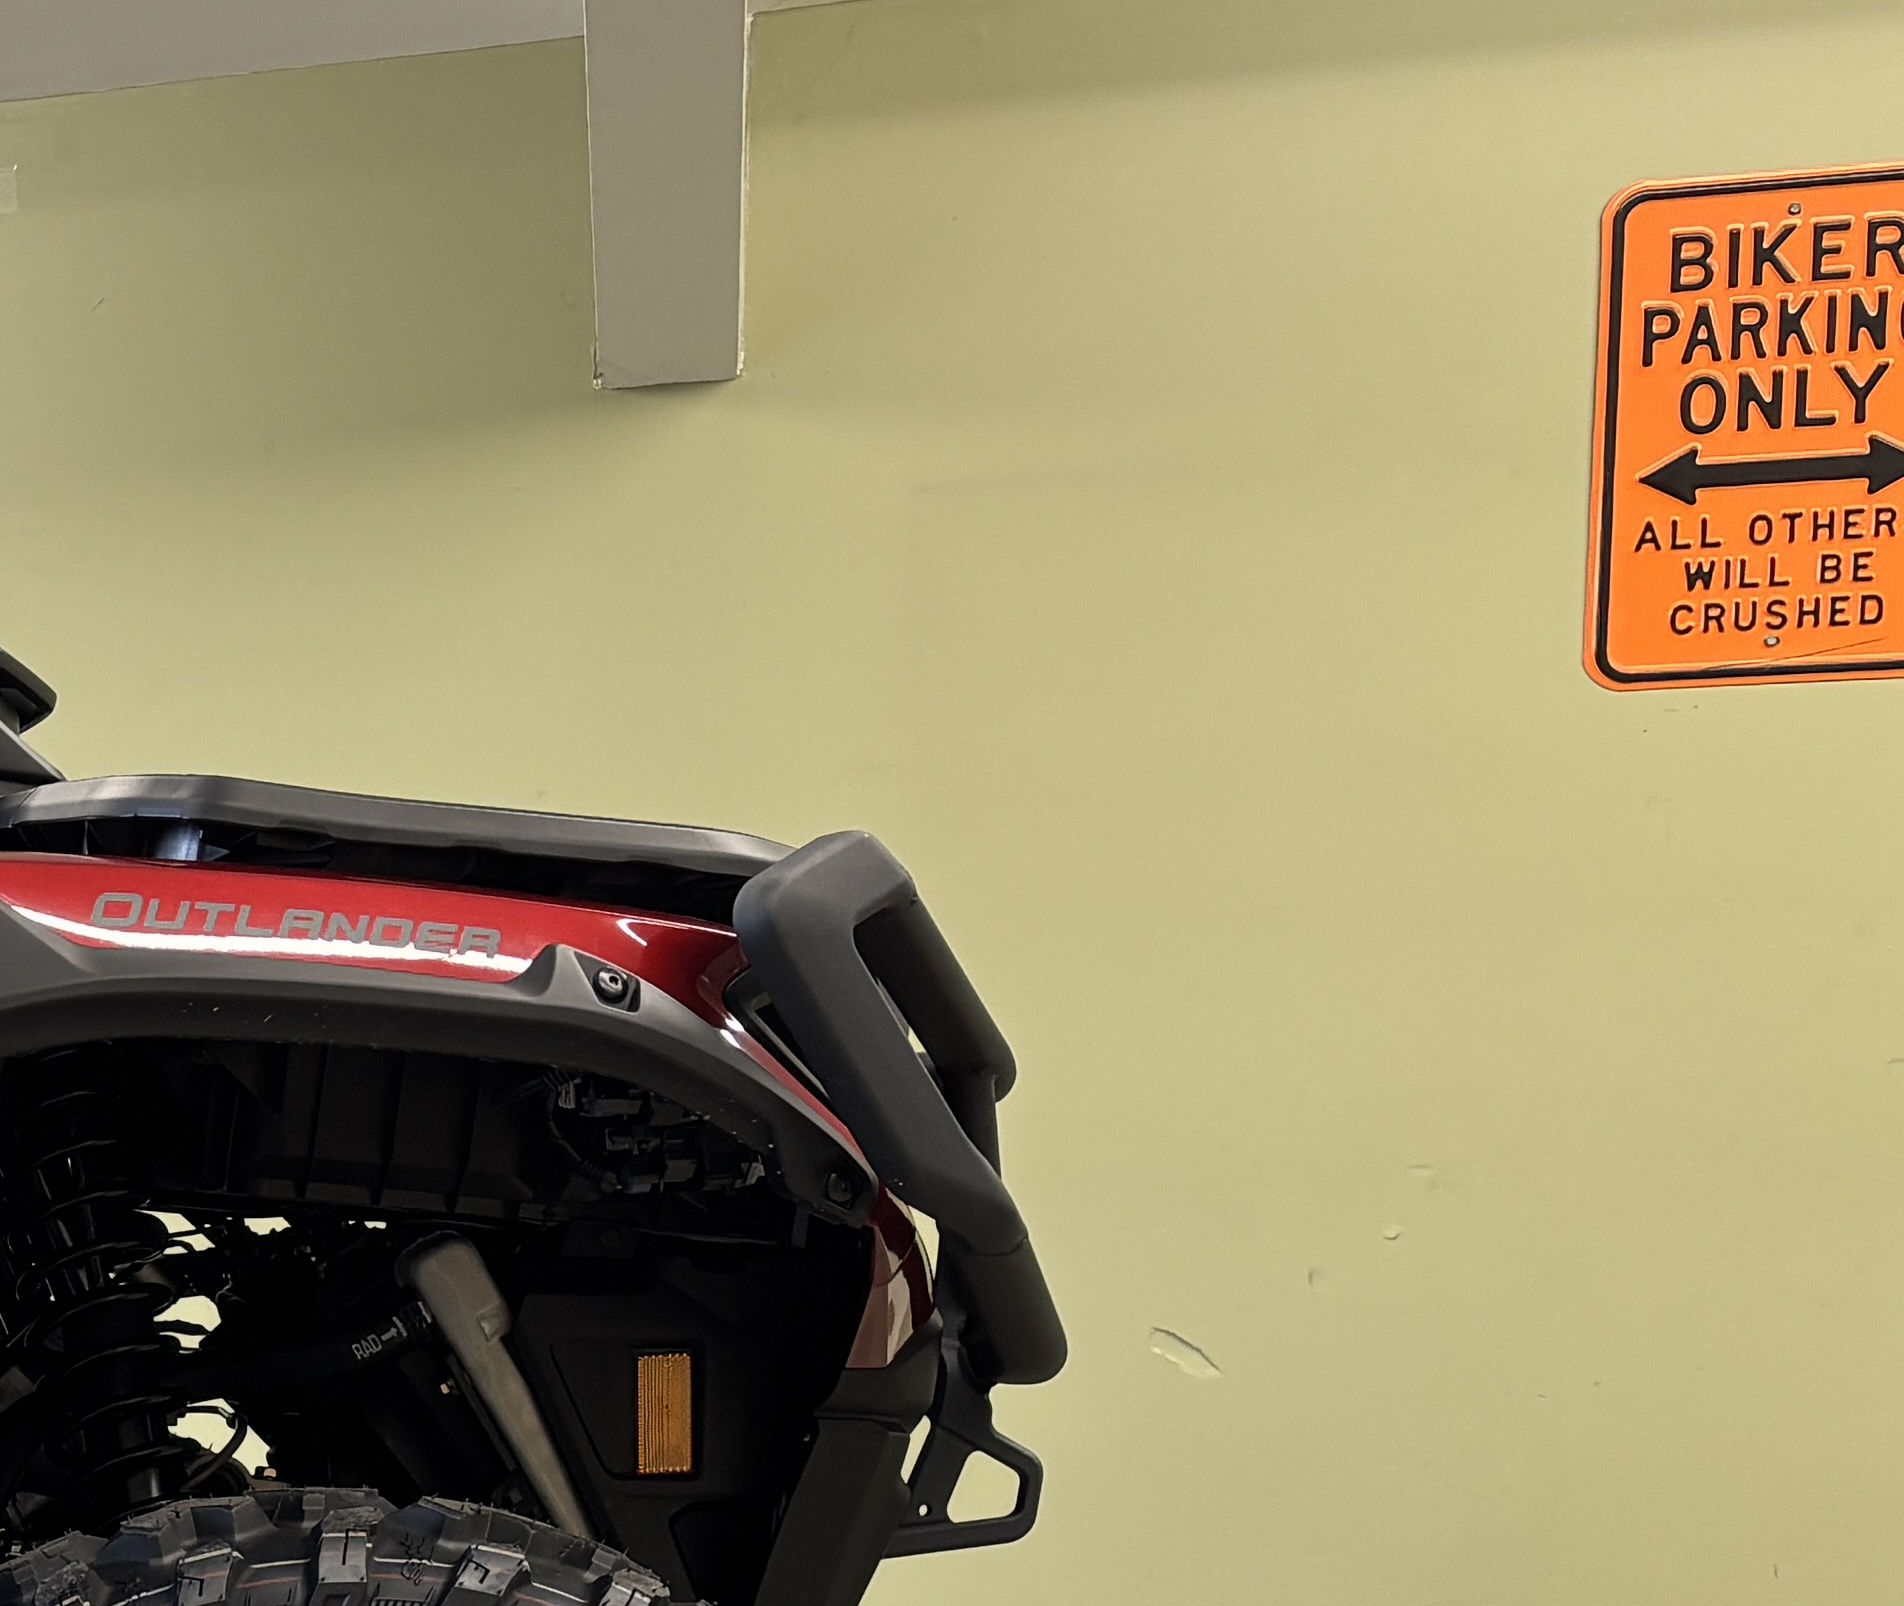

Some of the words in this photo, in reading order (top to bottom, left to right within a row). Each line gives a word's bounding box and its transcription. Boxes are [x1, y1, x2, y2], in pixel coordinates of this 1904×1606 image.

[1641, 290, 1904, 368] PARKIN
[1679, 360, 1892, 435] ONLY
[1634, 516, 1723, 552] ALL
[1748, 507, 1897, 546] OTHER
[1684, 555, 1790, 592] WILL
[1818, 550, 1875, 585] BE
[1669, 594, 1885, 636] CRUSHED
[90, 891, 502, 958] OUTLANDER
[352, 1334, 382, 1360] RAD
